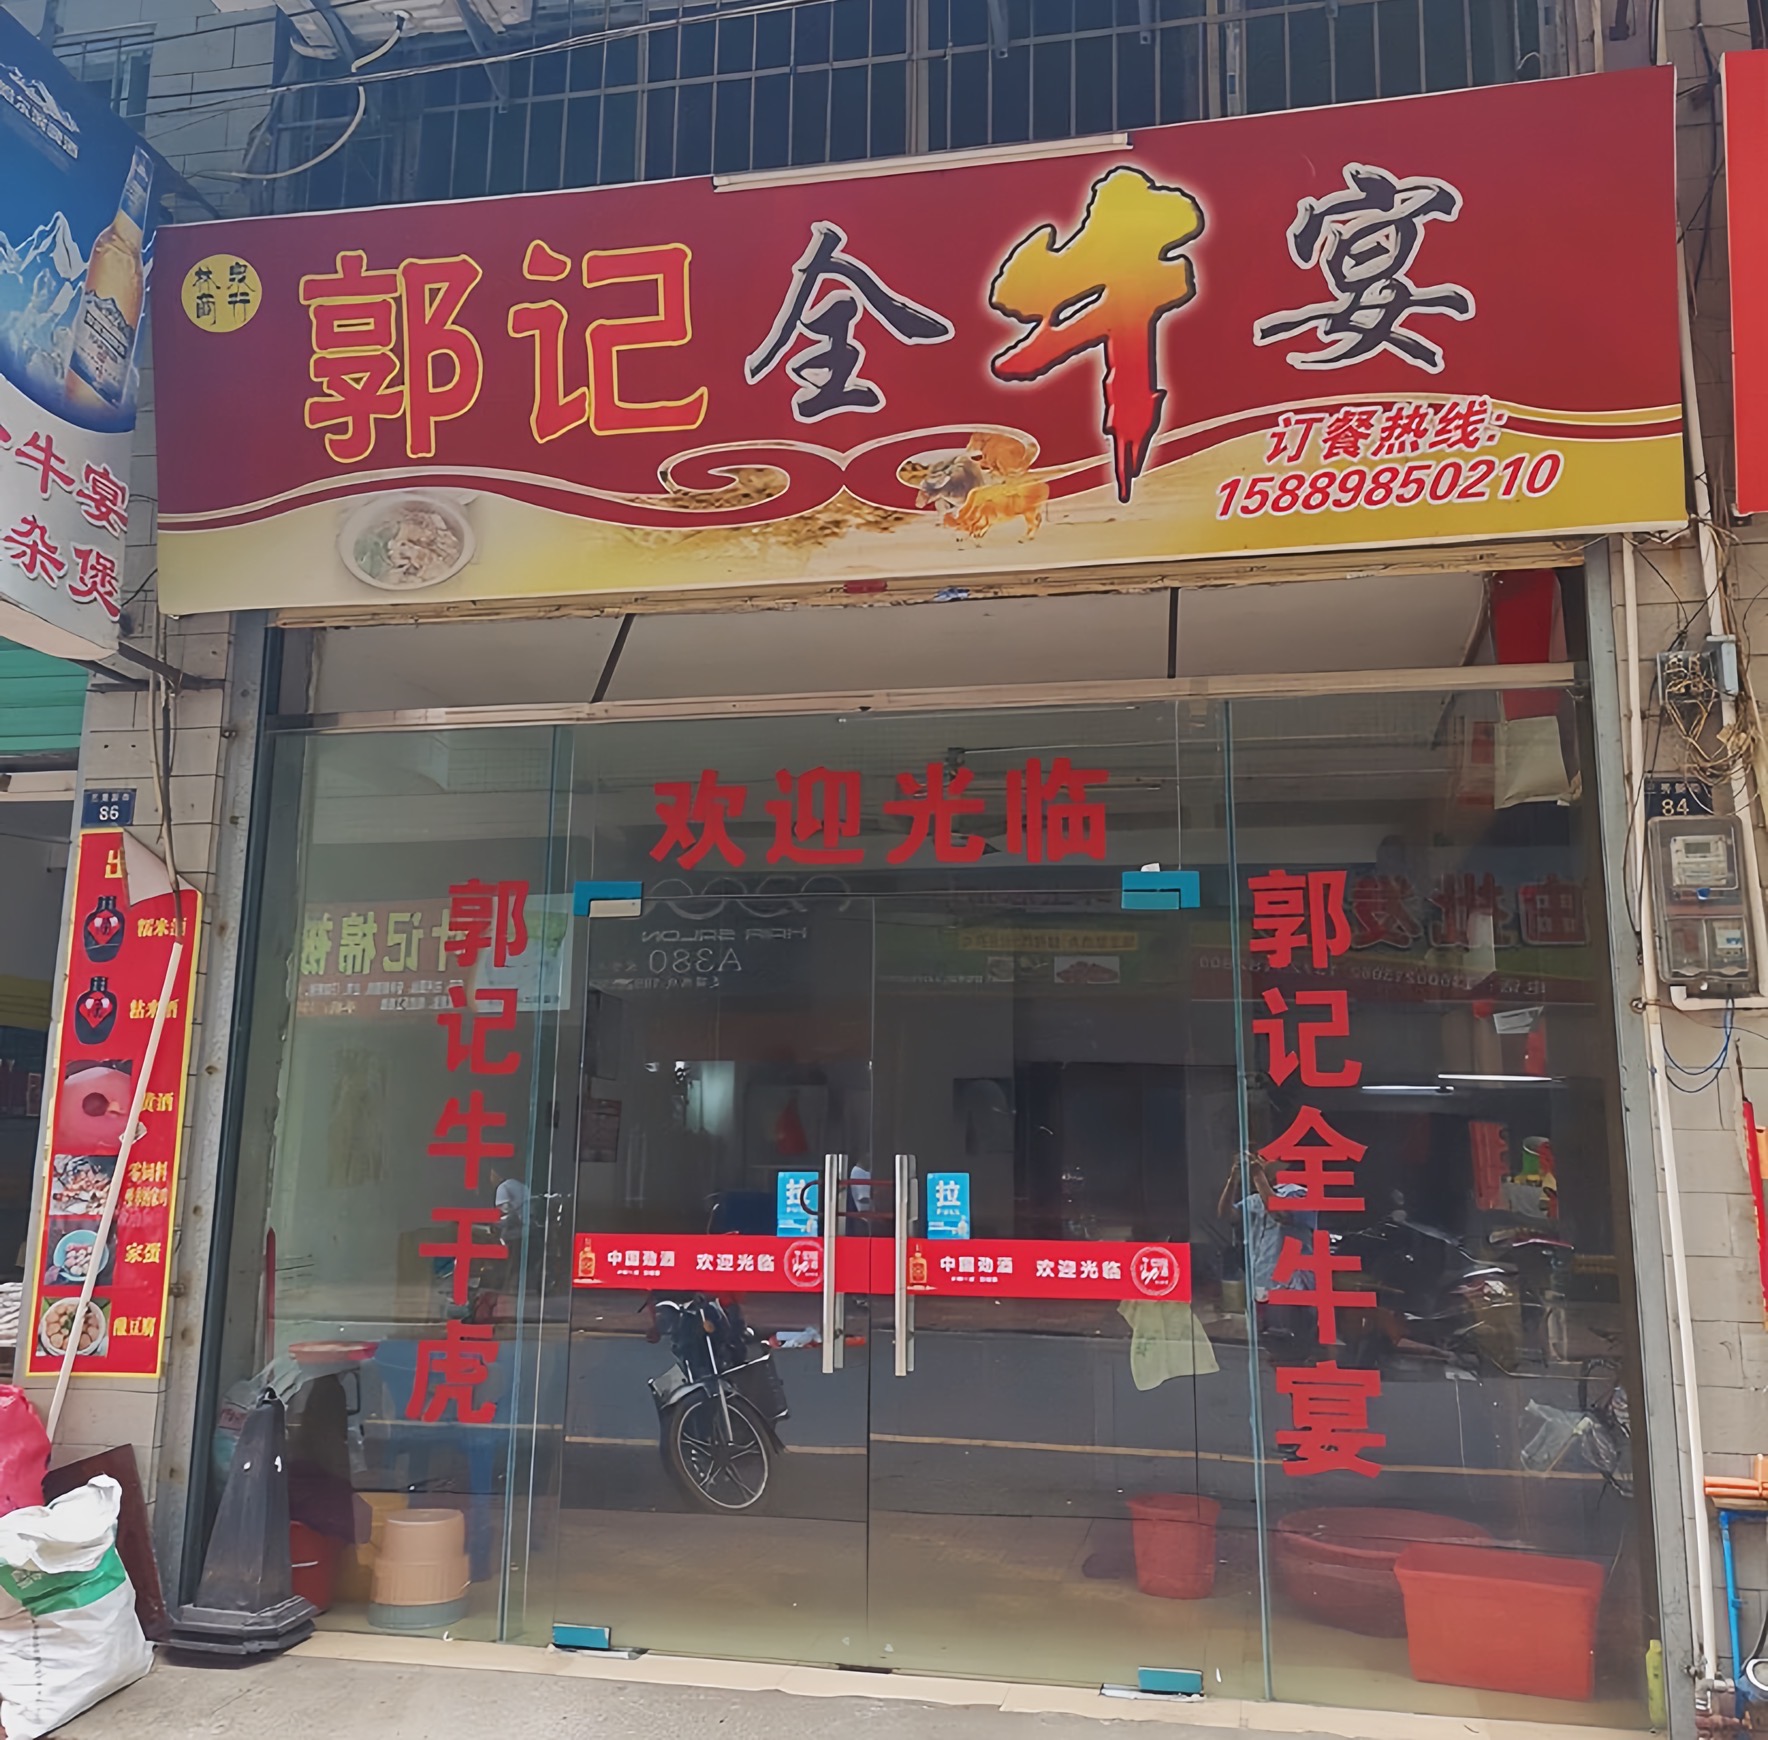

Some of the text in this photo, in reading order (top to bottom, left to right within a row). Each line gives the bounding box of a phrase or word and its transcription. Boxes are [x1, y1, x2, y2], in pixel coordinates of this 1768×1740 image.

[0, 423, 131, 538] 牛宴
[1216, 451, 1563, 518] 15889850210
[649, 758, 1110, 870] 欢迎光临
[1661, 798, 1690, 817] 84
[935, 1180, 961, 1207] 拉
[1248, 869, 1386, 1478] 郭记全牛宴
[695, 1253, 776, 1272] 欢迎光临
[1035, 1257, 1122, 1280] 欢迎光临
